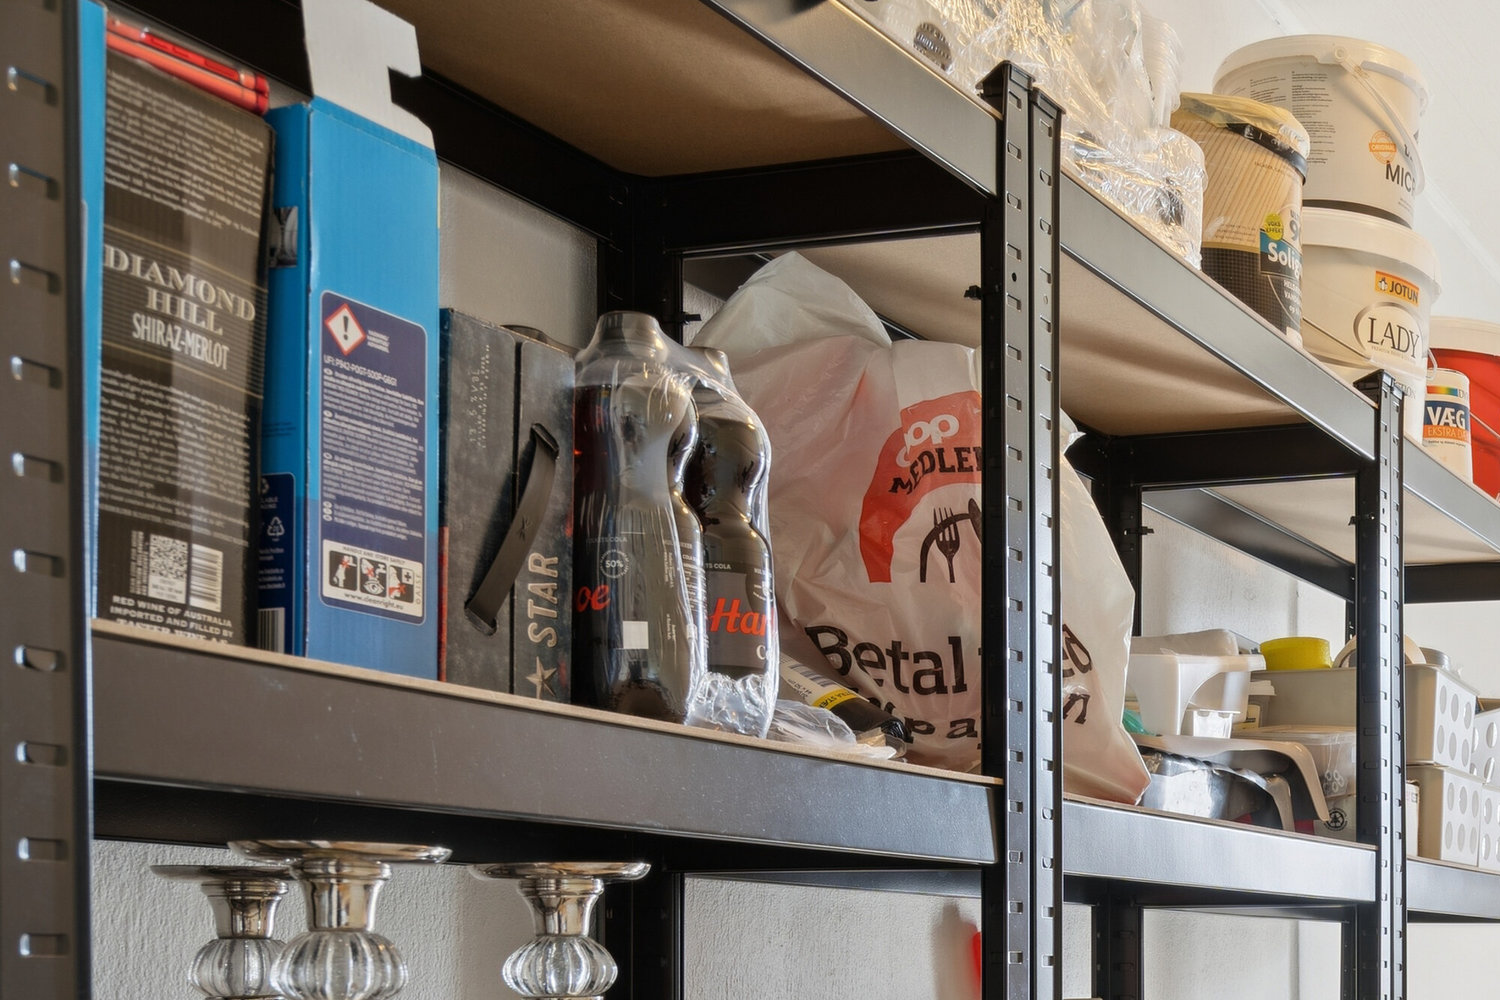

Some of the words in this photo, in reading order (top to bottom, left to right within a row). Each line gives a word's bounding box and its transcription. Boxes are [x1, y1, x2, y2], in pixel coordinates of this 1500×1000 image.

[103, 244, 256, 321] DIAMOND
[1389, 281, 1418, 303] JOTUN
[146, 287, 223, 336] HILL
[132, 312, 230, 370] SHIRAZ-MERLOT
[1367, 317, 1420, 358] LADY
[1427, 406, 1466, 429] VÆG
[888, 447, 982, 495] MEDLE
[605, 559, 624, 569] 50%
[112, 595, 135, 607] RED
[137, 600, 166, 613] WINE
[167, 607, 183, 616] OF
[183, 610, 232, 627] AUSTRALIA
[528, 552, 558, 647] STAR
[110, 606, 164, 623] IMPORTED
[166, 617, 188, 628] AND
[189, 621, 221, 635] FILLED
[222, 629, 234, 638] BY
[804, 625, 968, 696] Betal
